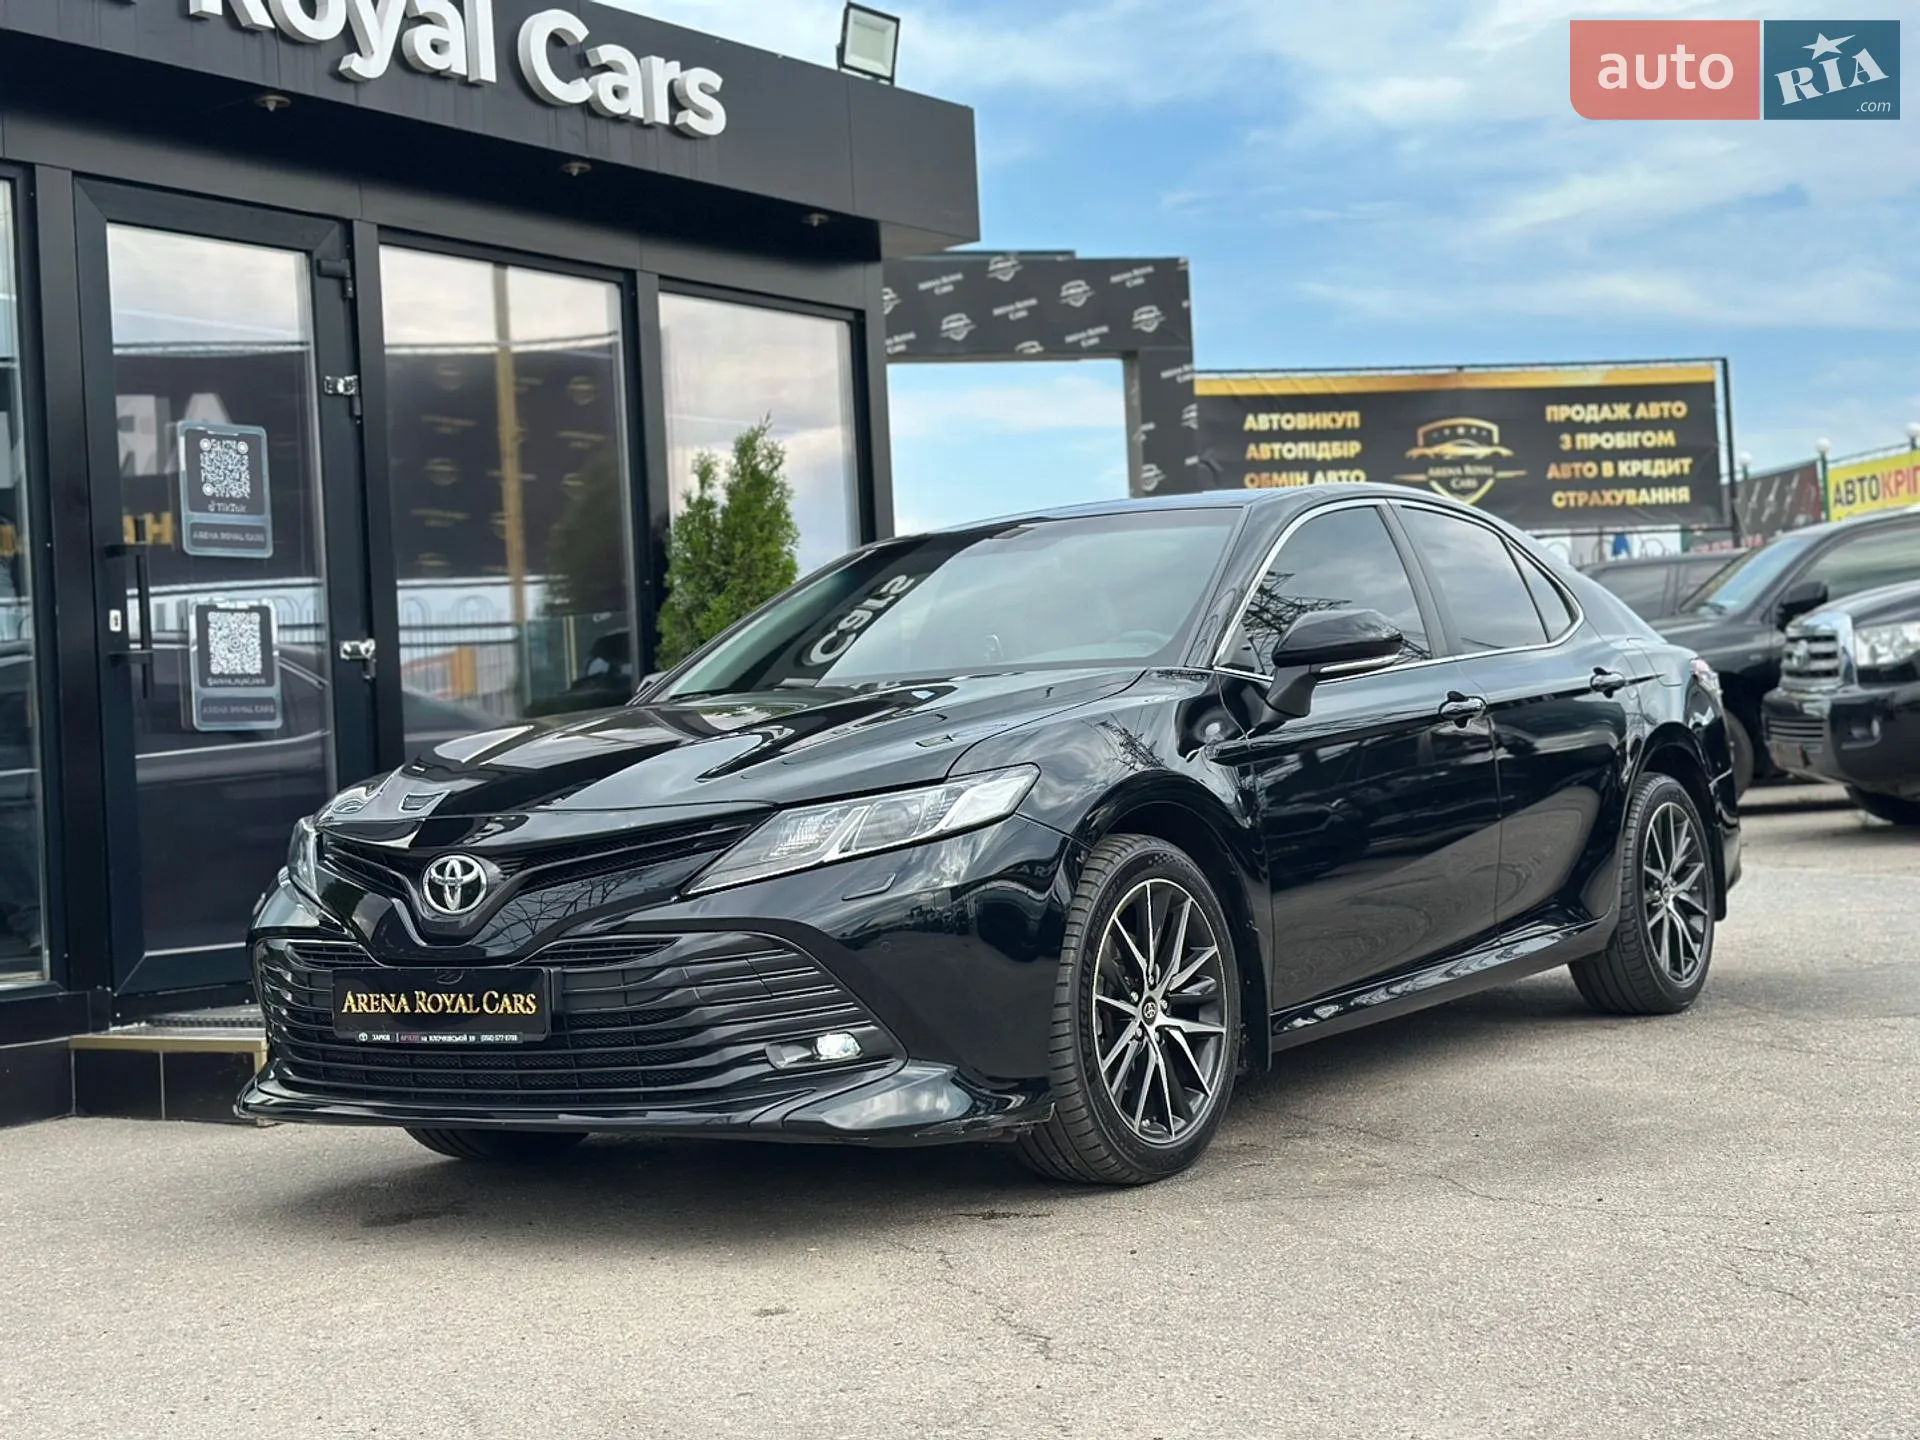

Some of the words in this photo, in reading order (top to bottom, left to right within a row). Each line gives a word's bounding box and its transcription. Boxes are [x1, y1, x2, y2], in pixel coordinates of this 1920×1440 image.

[189, 0, 496, 84] oyal
[517, 8, 728, 138] Cars
[1243, 411, 1361, 431] АВТОВИКУП
[1545, 402, 1632, 424] ПРОДАЖ
[1635, 400, 1688, 420] АВТО
[1246, 440, 1362, 461] АВТОПІДБІР
[1575, 430, 1677, 451] ПРОБІГОМ
[1244, 471, 1309, 488] ОБМІН
[1313, 469, 1367, 485] АВТО
[1547, 461, 1599, 480] АВТО
[1602, 460, 1615, 478] В
[1618, 457, 1693, 478] КРЕДИТ
[1551, 486, 1691, 508] СТРАХУВАННЯ
[341, 990, 411, 1014] ARENA
[414, 990, 480, 1014] ROYAL
[482, 990, 537, 1015] CARS
